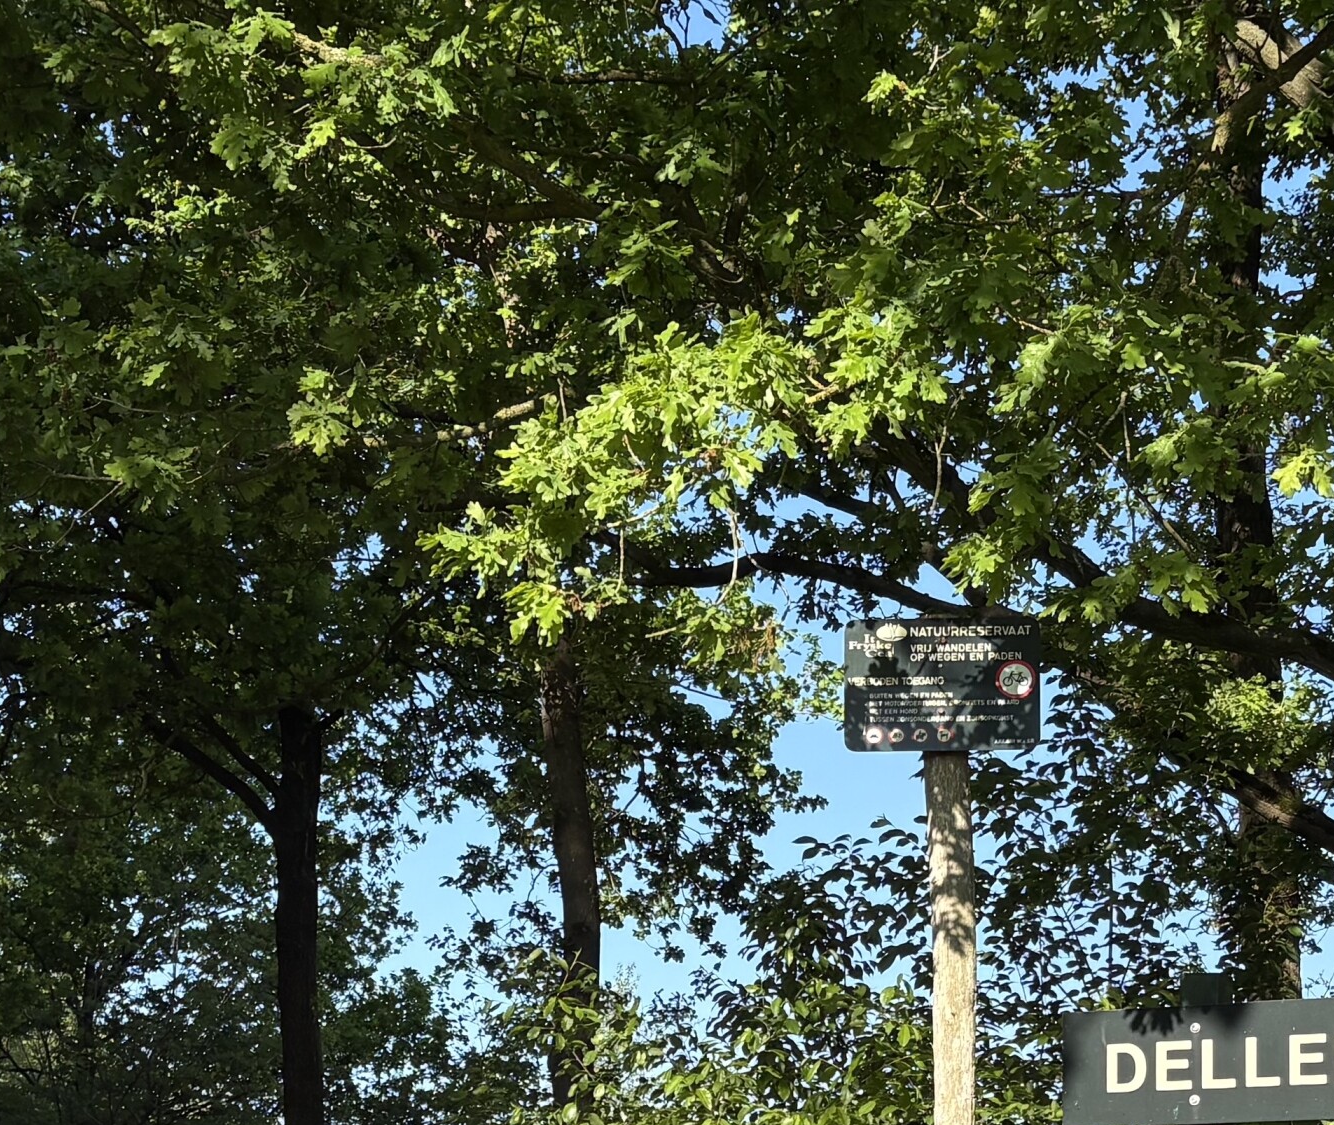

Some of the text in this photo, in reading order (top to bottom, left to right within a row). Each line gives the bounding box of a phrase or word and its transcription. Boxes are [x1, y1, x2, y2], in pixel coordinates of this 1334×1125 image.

[910, 625, 1031, 637] NATUURRESERVAAT
[848, 640, 892, 652] Fryske
[910, 643, 992, 653] VRIJ WANDELEN
[910, 652, 1022, 662] OP WEGEN EN PADEN
[848, 676, 945, 687] VERBODEN TOEGANG
